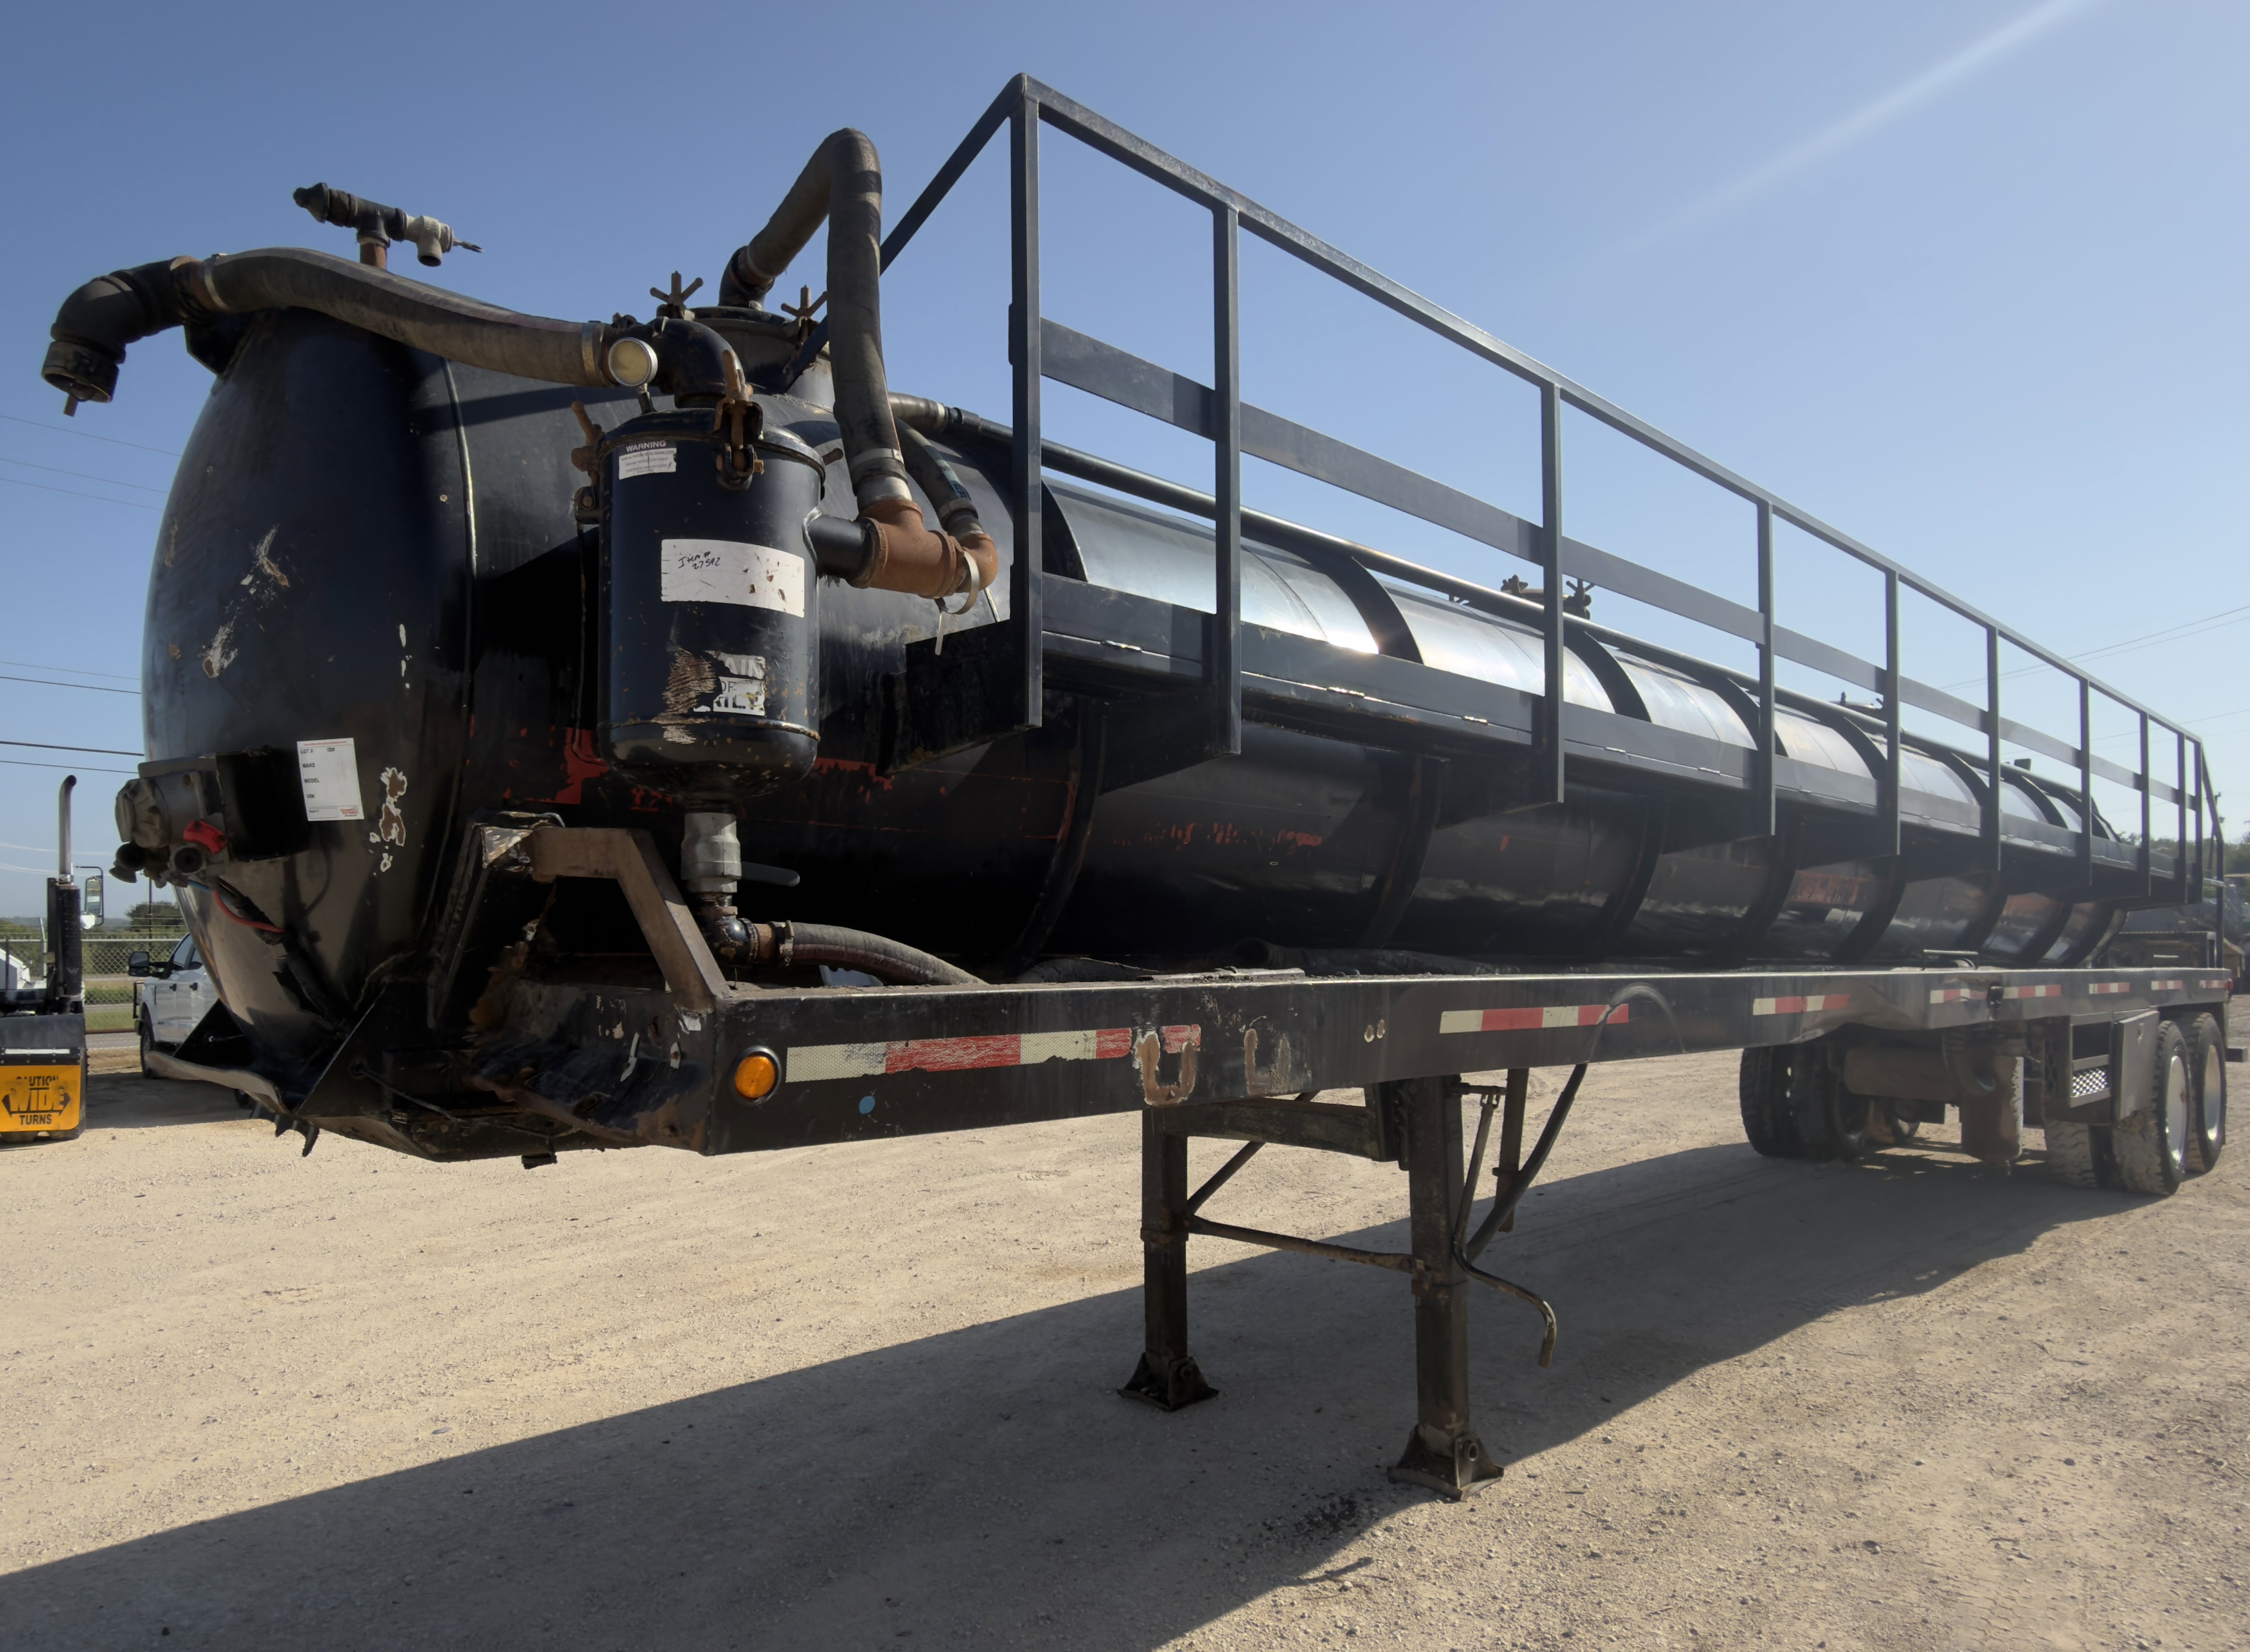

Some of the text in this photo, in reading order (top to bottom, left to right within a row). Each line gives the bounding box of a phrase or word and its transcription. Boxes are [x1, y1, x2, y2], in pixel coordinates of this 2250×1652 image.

[626, 441, 666, 452] WARNING
[725, 657, 765, 679] AIN
[16, 1076, 59, 1086] UTIO
[20, 1114, 52, 1125] TURNS
